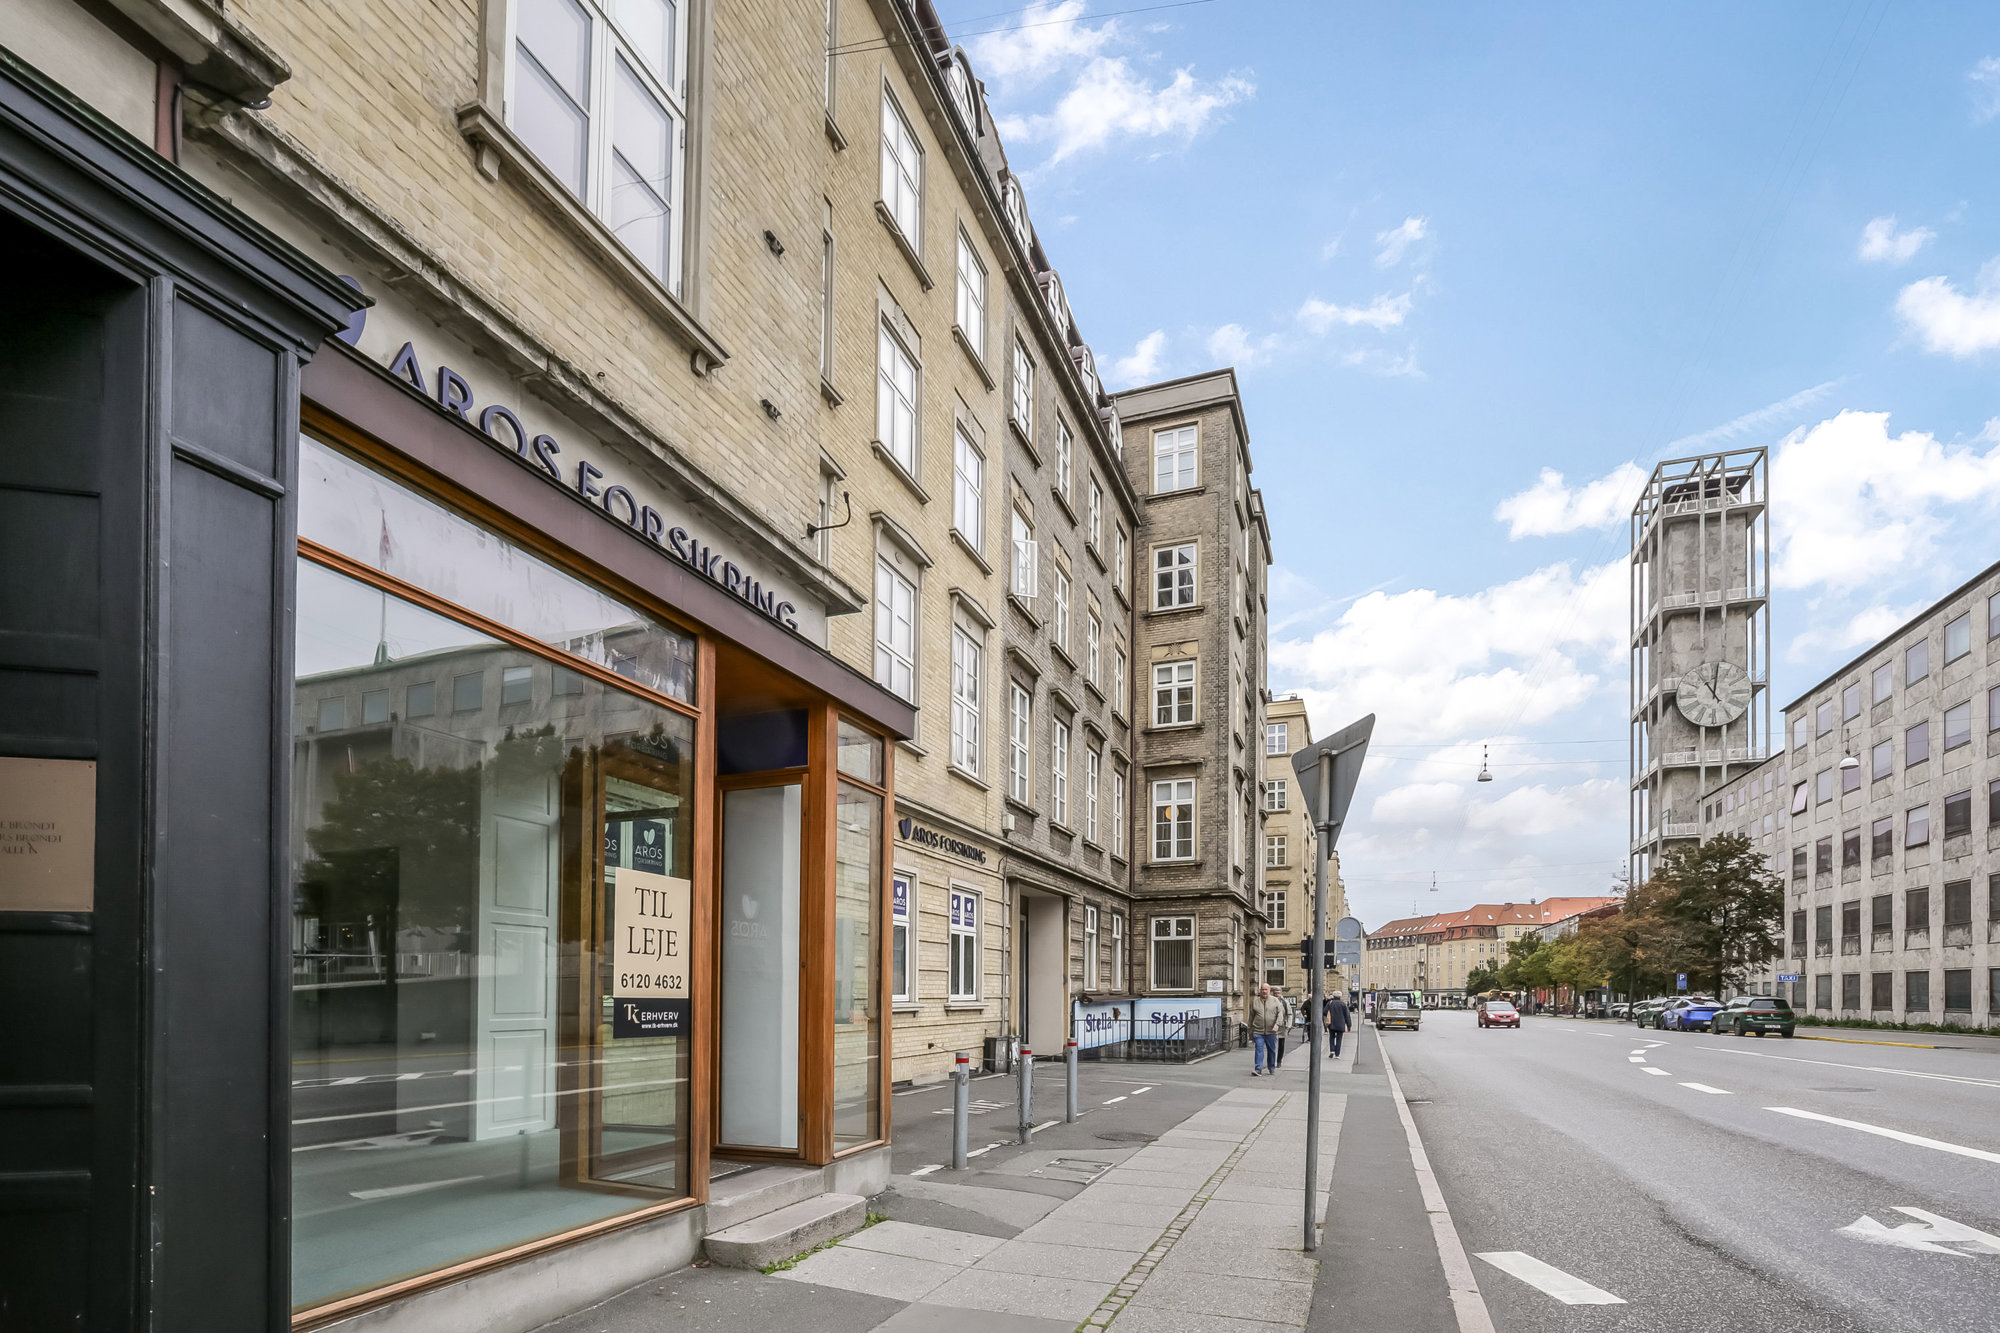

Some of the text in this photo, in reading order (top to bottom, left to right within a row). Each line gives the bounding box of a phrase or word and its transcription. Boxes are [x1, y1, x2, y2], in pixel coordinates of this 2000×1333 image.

[389, 341, 799, 633] AROS FORSIKRING
[634, 845, 663, 860] AROS
[912, 825, 986, 864] AROS FORSIKRING
[634, 887, 673, 919] TIL
[627, 926, 678, 962] LEJE
[621, 973, 682, 990] 6120 4632
[641, 1011, 679, 1021] ERHVERV
[1086, 1012, 1112, 1032] Stella
[1151, 1011, 1199, 1025] Stella
